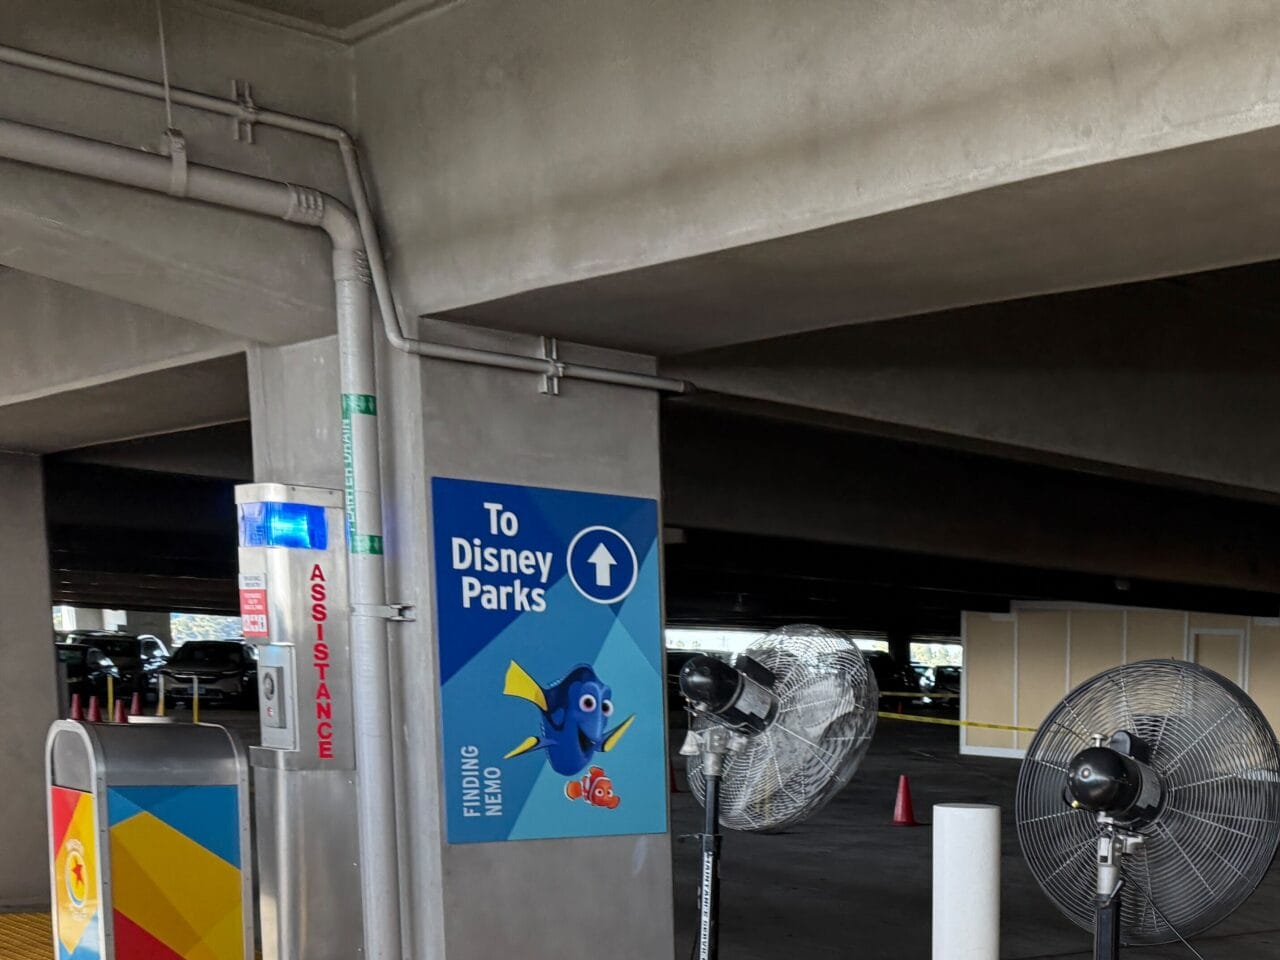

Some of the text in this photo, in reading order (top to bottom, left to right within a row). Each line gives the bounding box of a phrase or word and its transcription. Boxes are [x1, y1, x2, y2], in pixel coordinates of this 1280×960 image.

[482, 501, 519, 537] To
[451, 536, 553, 584] Disney
[461, 575, 547, 613] Parks
[310, 563, 334, 759] ASSISTANCE
[460, 745, 481, 817] FINDING
[483, 766, 502, 816] NEMO
